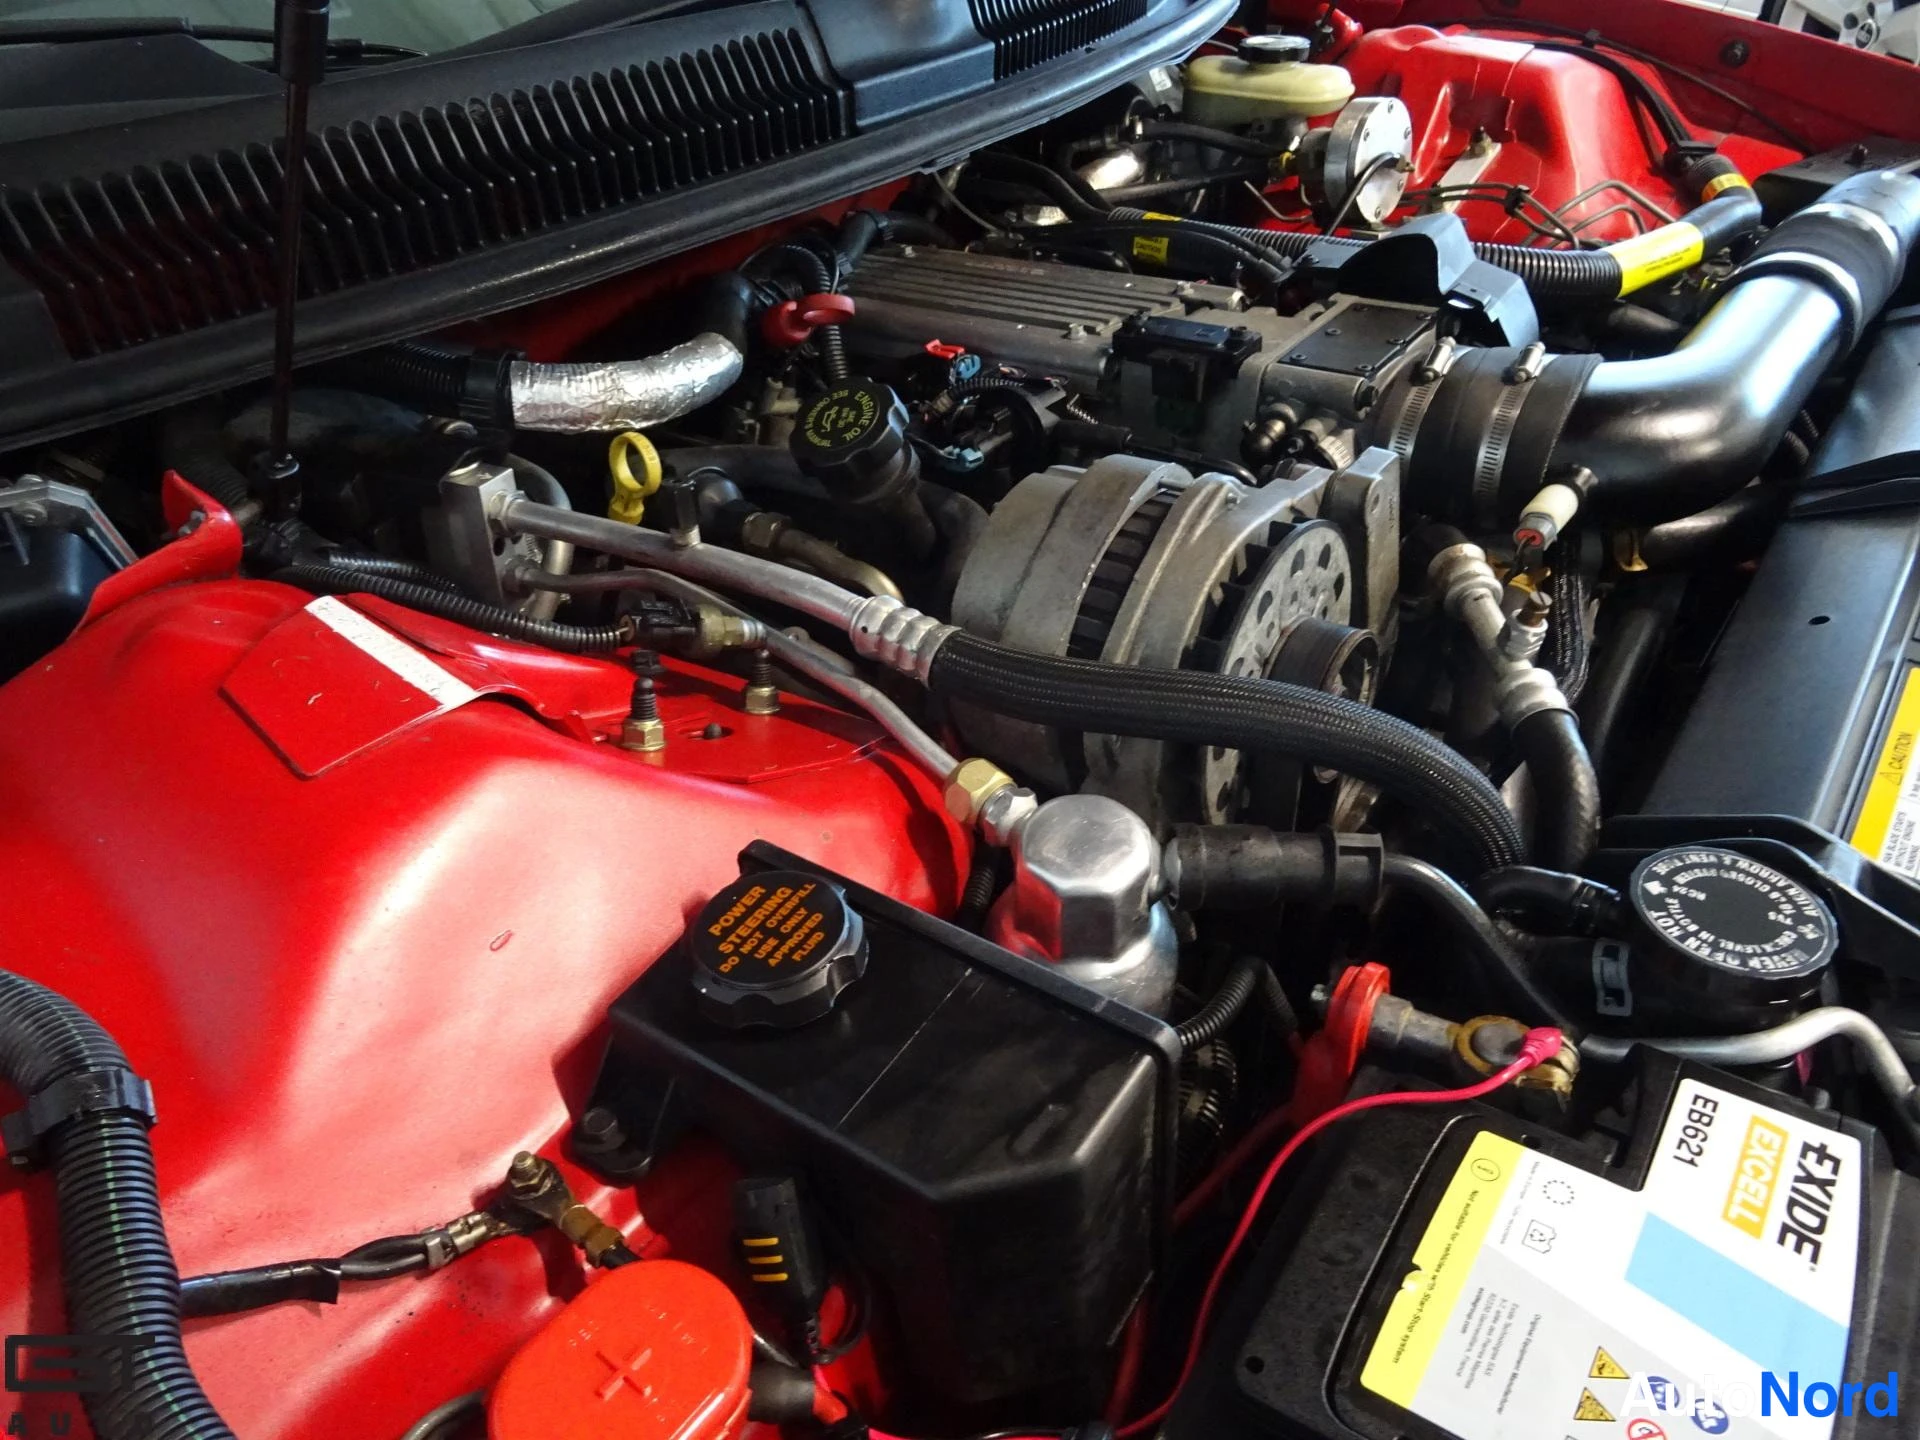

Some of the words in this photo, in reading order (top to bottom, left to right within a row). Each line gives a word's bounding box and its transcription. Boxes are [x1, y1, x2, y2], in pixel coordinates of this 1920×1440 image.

[854, 391, 874, 426] ENGINE
[842, 428, 861, 441] OIL
[1888, 732, 1913, 770] CAUTION
[1685, 854, 1718, 864] VENT
[1736, 860, 1787, 888] ARROW
[1672, 868, 1718, 885] SYSTEM
[1719, 869, 1770, 892] CLOSED
[708, 885, 767, 936] POWER
[718, 886, 794, 953] STEERING
[1650, 910, 1684, 937] HOT
[1664, 897, 1699, 932] BOTTLE
[719, 955, 740, 973] DO
[739, 930, 764, 954] NOT
[765, 883, 817, 928] OVERFILL
[753, 936, 780, 960] USE
[779, 907, 809, 933] ONLY
[767, 912, 823, 968] APPROVED
[1698, 931, 1716, 944] IN
[792, 931, 825, 962] FLUID
[1684, 936, 1741, 966] OPEN
[1719, 938, 1763, 954] LEVEL
[1748, 949, 1809, 970] NEVER
[1673, 1094, 1719, 1167] EB621
[1727, 1124, 1783, 1223] EXCELL
[1467, 1189, 1479, 1202] Not
[1776, 1141, 1842, 1265] EXIDE
[1454, 1202, 1471, 1230] suitable
[1434, 1243, 1452, 1274] vehicles
[1391, 1333, 1411, 1364] system
